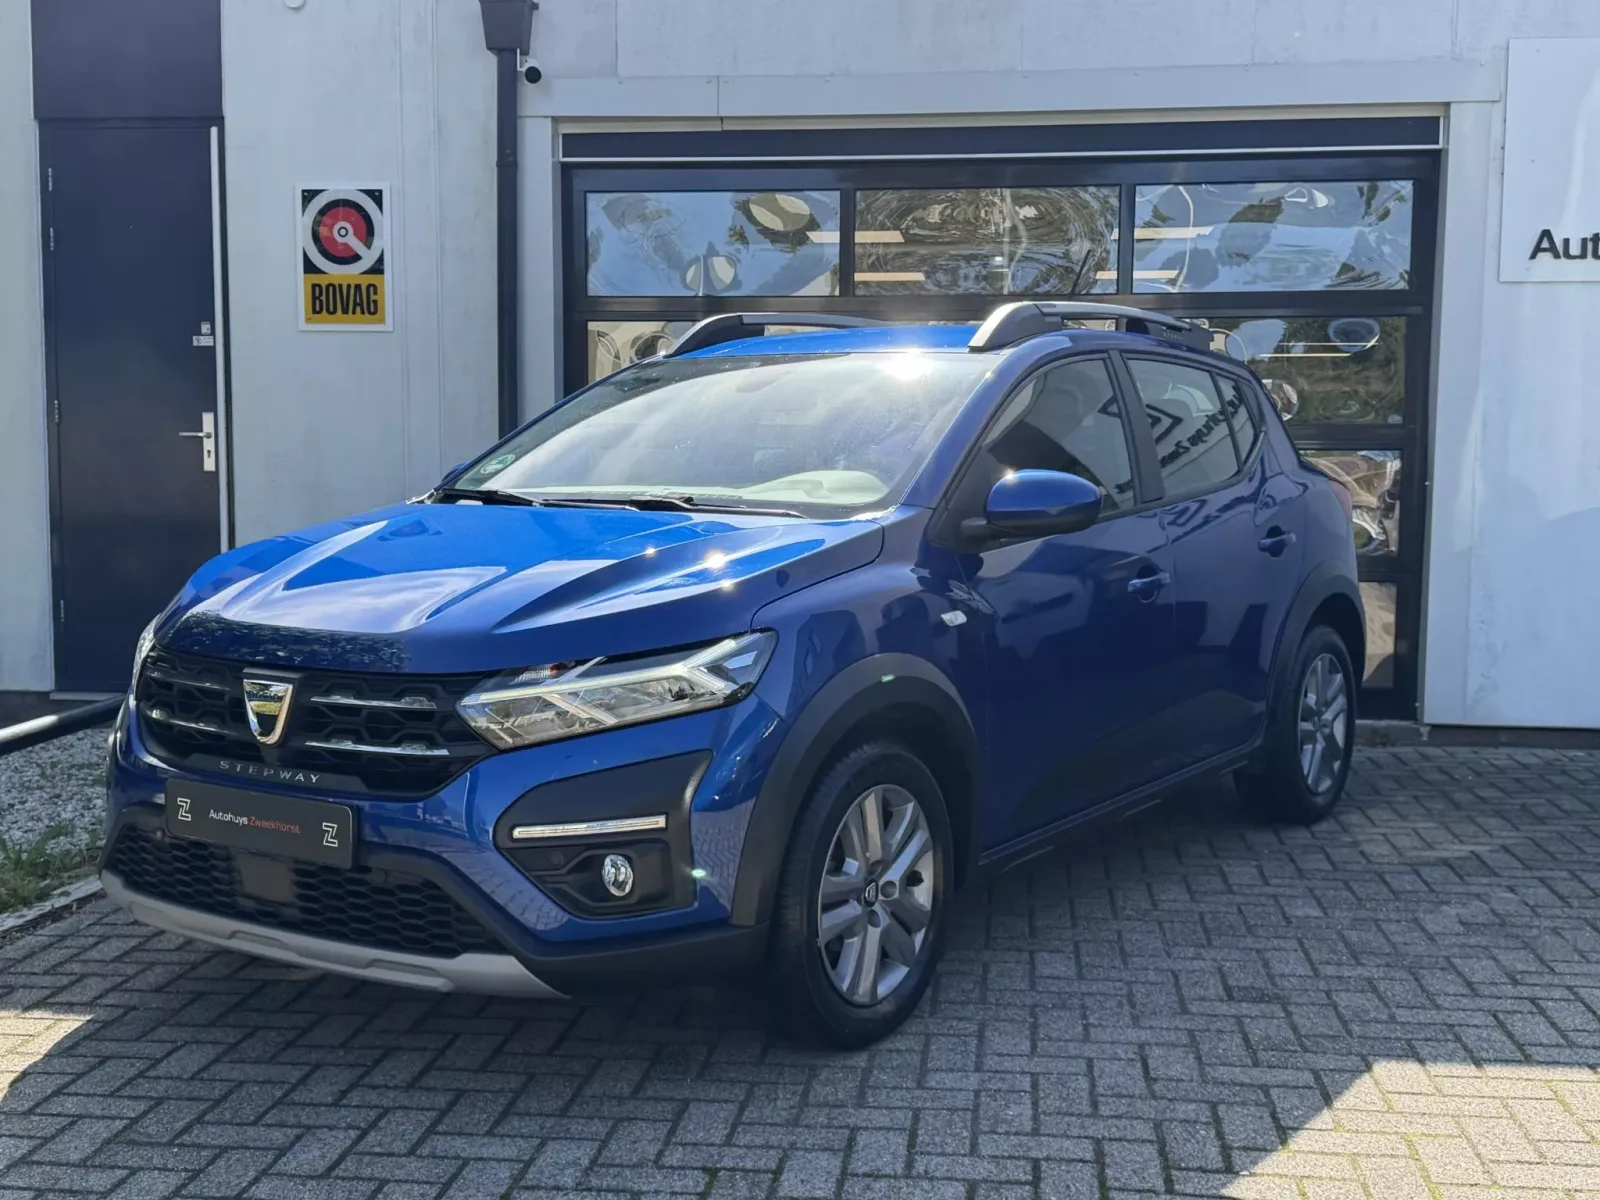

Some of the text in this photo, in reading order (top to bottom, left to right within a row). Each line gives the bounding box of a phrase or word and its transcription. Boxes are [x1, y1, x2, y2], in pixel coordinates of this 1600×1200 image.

[1528, 228, 1600, 261] Aut
[311, 283, 379, 316] BOVAG
[219, 760, 320, 783] STEPWAY
[209, 809, 301, 834] Autohuys Zweekhorst
